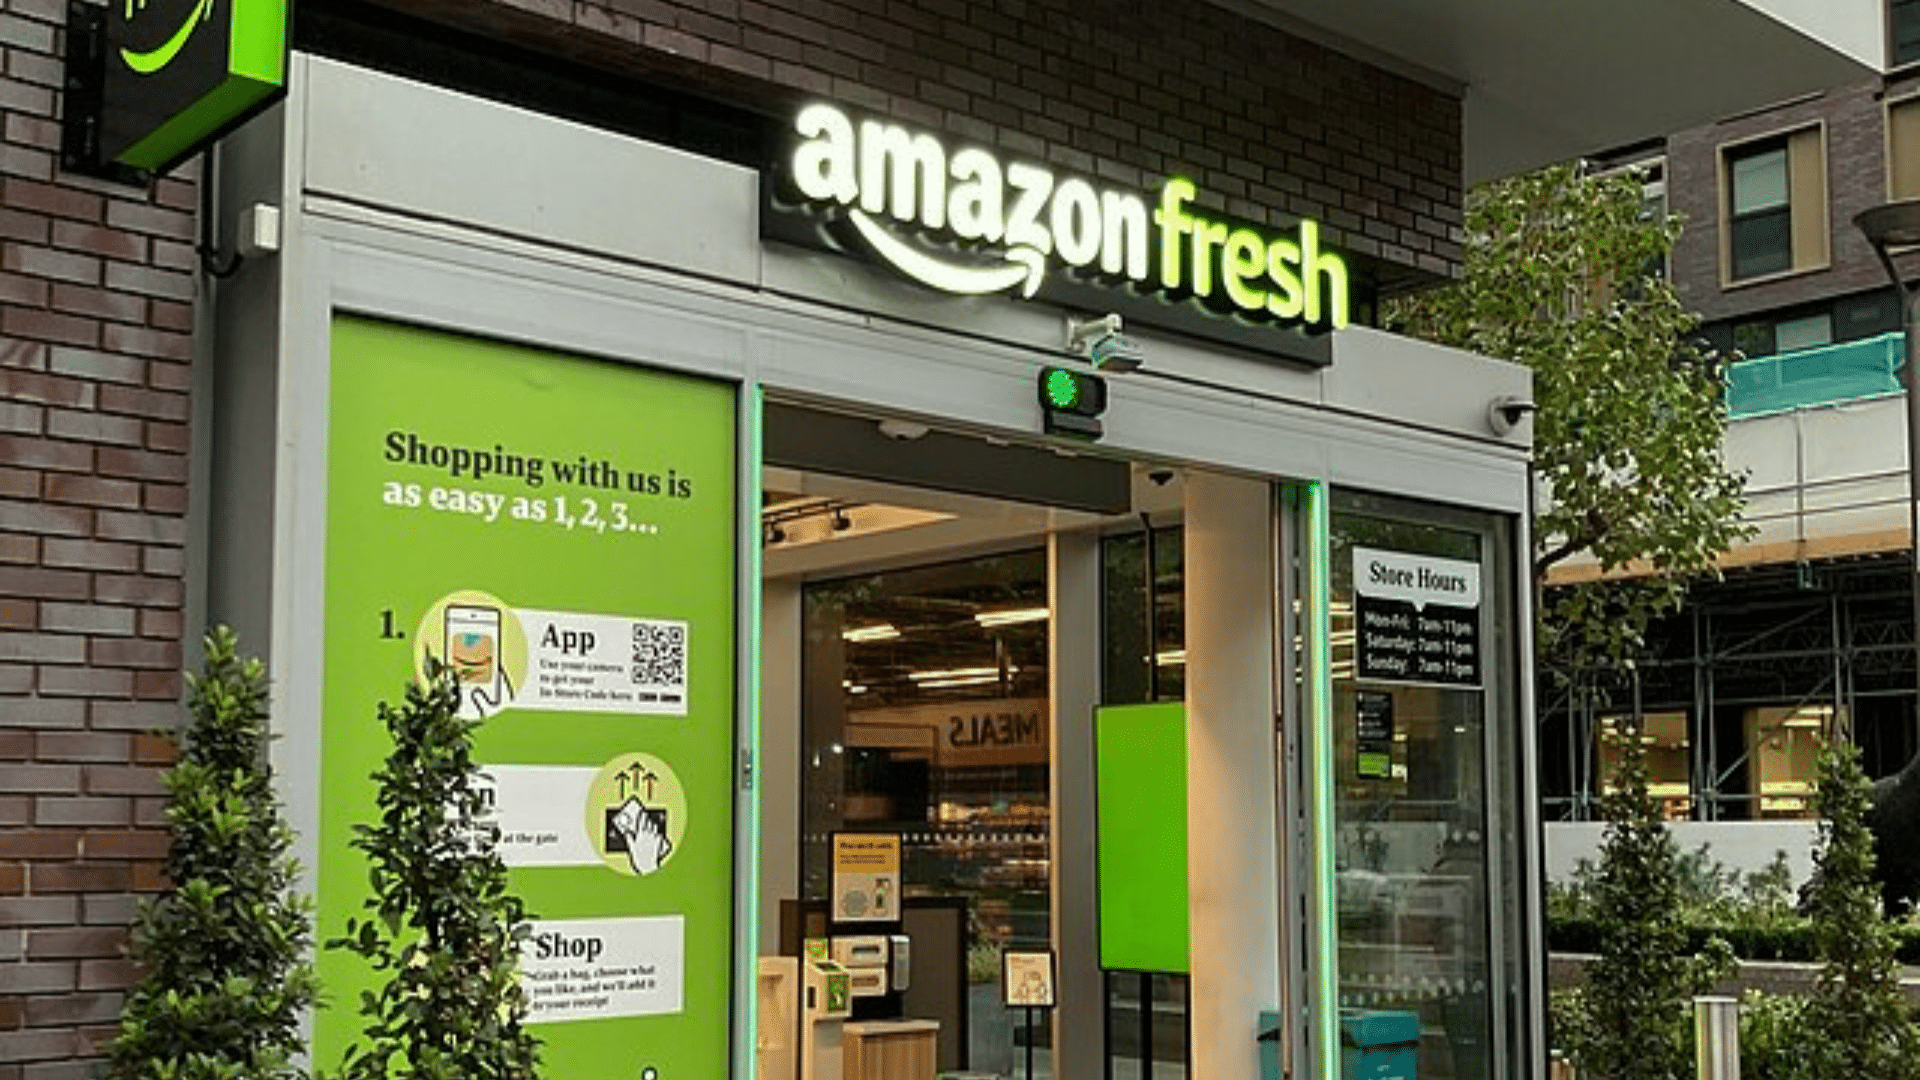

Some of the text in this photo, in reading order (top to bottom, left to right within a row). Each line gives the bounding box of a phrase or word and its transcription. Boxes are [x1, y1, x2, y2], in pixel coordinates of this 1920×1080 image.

[792, 103, 1349, 330] amazon fresh
[385, 431, 691, 498] Shopping with us is
[383, 481, 422, 507] as
[428, 486, 506, 523] easy
[511, 496, 547, 522] as
[1370, 560, 1468, 594] Store Hours
[379, 610, 405, 639] 1.
[541, 622, 596, 656] App
[536, 931, 603, 963] Shop
